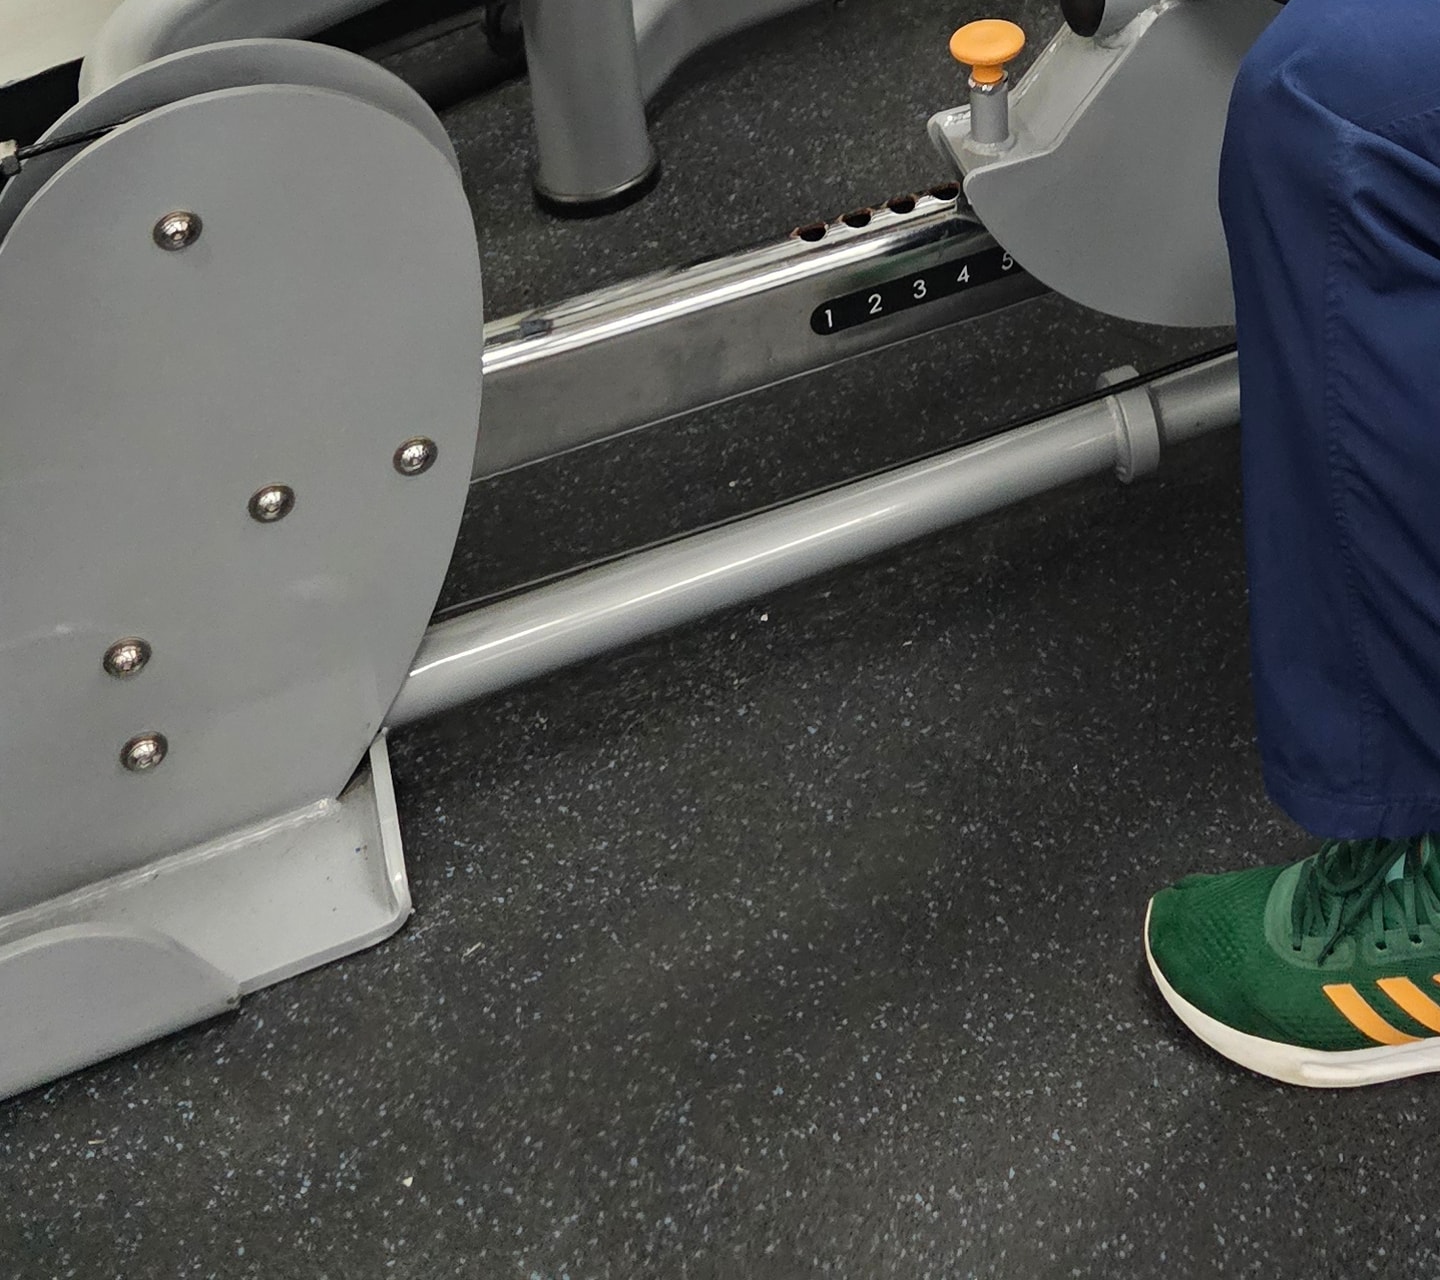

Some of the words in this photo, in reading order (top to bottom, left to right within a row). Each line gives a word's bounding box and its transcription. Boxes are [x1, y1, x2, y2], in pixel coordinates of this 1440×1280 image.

[824, 309, 833, 328] 1
[868, 293, 883, 314] 2
[913, 279, 927, 299] 3
[957, 265, 970, 283] 4
[1001, 252, 1014, 271] 5
